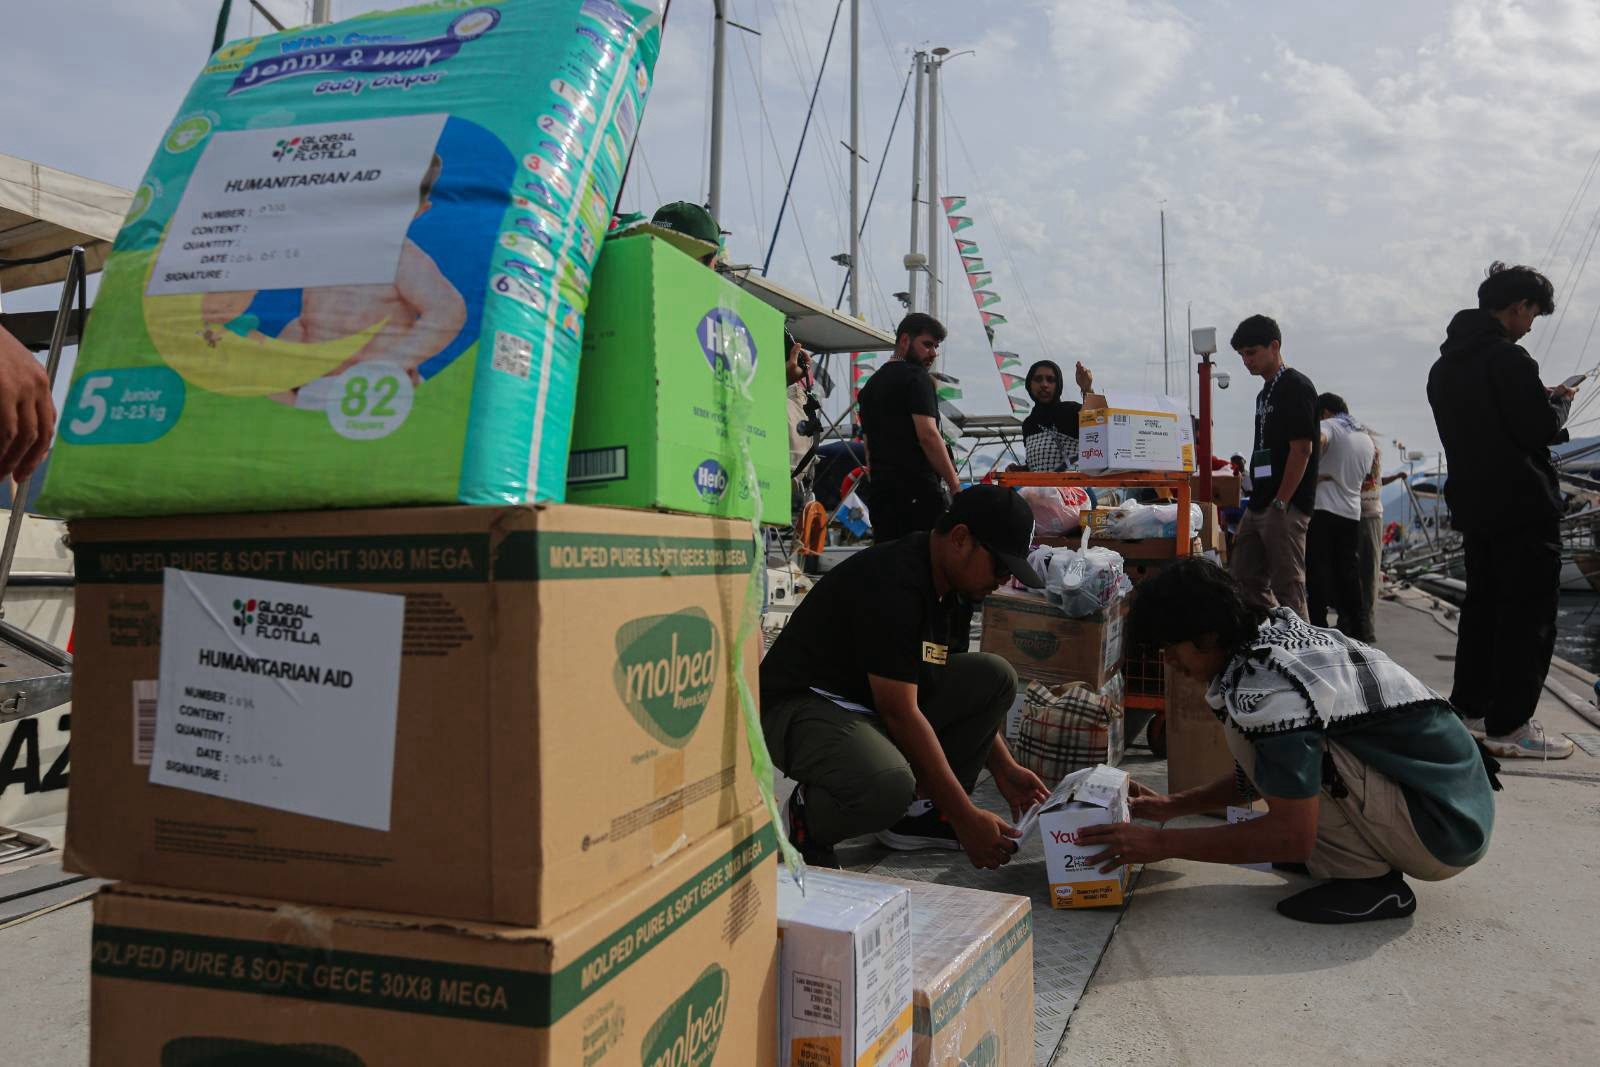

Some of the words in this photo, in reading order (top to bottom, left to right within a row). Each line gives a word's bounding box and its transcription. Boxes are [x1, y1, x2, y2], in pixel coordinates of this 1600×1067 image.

[342, 49, 363, 66] &
[373, 48, 441, 67] Willy
[314, 78, 367, 95] Baby
[371, 71, 440, 91] Diaper
[557, 81, 566, 93] 1
[543, 117, 554, 130] 2
[300, 132, 355, 145] GLOBAL
[292, 149, 356, 162] FLOTILLA
[527, 156, 541, 171] 3
[224, 171, 349, 193] HUMANITARIAN
[348, 169, 381, 183] AID
[201, 209, 246, 220] NUMBER
[191, 224, 241, 236] CONTENT
[182, 240, 234, 251] QUANTITY
[200, 254, 227, 264] DATE
[164, 270, 223, 282] SIGNATURE
[496, 276, 510, 292] 6
[119, 388, 162, 403] Junior
[340, 375, 400, 418] 82
[69, 376, 114, 436] 5
[110, 406, 147, 421] 12-25
[149, 405, 167, 423] kg
[698, 466, 726, 490] Hero
[100, 551, 165, 572] MOLPED
[169, 550, 218, 572] PURE
[223, 550, 234, 572] &
[238, 549, 284, 572] SOFT
[292, 548, 349, 572] NIGHT
[358, 548, 404, 571] 30X8
[411, 547, 473, 570] MEGA
[550, 545, 608, 569] MOLPED
[610, 546, 641, 567] PURE
[643, 548, 650, 567] &
[652, 547, 678, 567] SOFT
[681, 548, 704, 566] GECE
[258, 599, 313, 619] GLOBAL
[257, 612, 303, 630] SUMUD
[256, 625, 321, 645] FLOTILLA
[199, 648, 321, 684] HUMANITARIAN
[323, 668, 353, 689] AID
[626, 628, 716, 708] molped
[184, 685, 227, 704] NUMBER
[179, 704, 225, 723] CONTENT
[174, 723, 224, 743] QUANTITY
[196, 747, 222, 762] DATE
[165, 759, 220, 782] SIGNATURE
[1064, 854, 1075, 869] 2
[581, 935, 633, 991] MOLPED
[635, 912, 666, 950] PURE
[666, 907, 674, 925] &
[675, 886, 700, 914] SOFT
[700, 869, 724, 899] GECE
[742, 840, 763, 870] MEGA
[169, 948, 226, 977] PURE
[231, 955, 245, 979] &
[250, 957, 308, 984] SOFT
[313, 965, 373, 994] GECE
[381, 973, 432, 1002] 30X8
[438, 979, 510, 1011] MEGA
